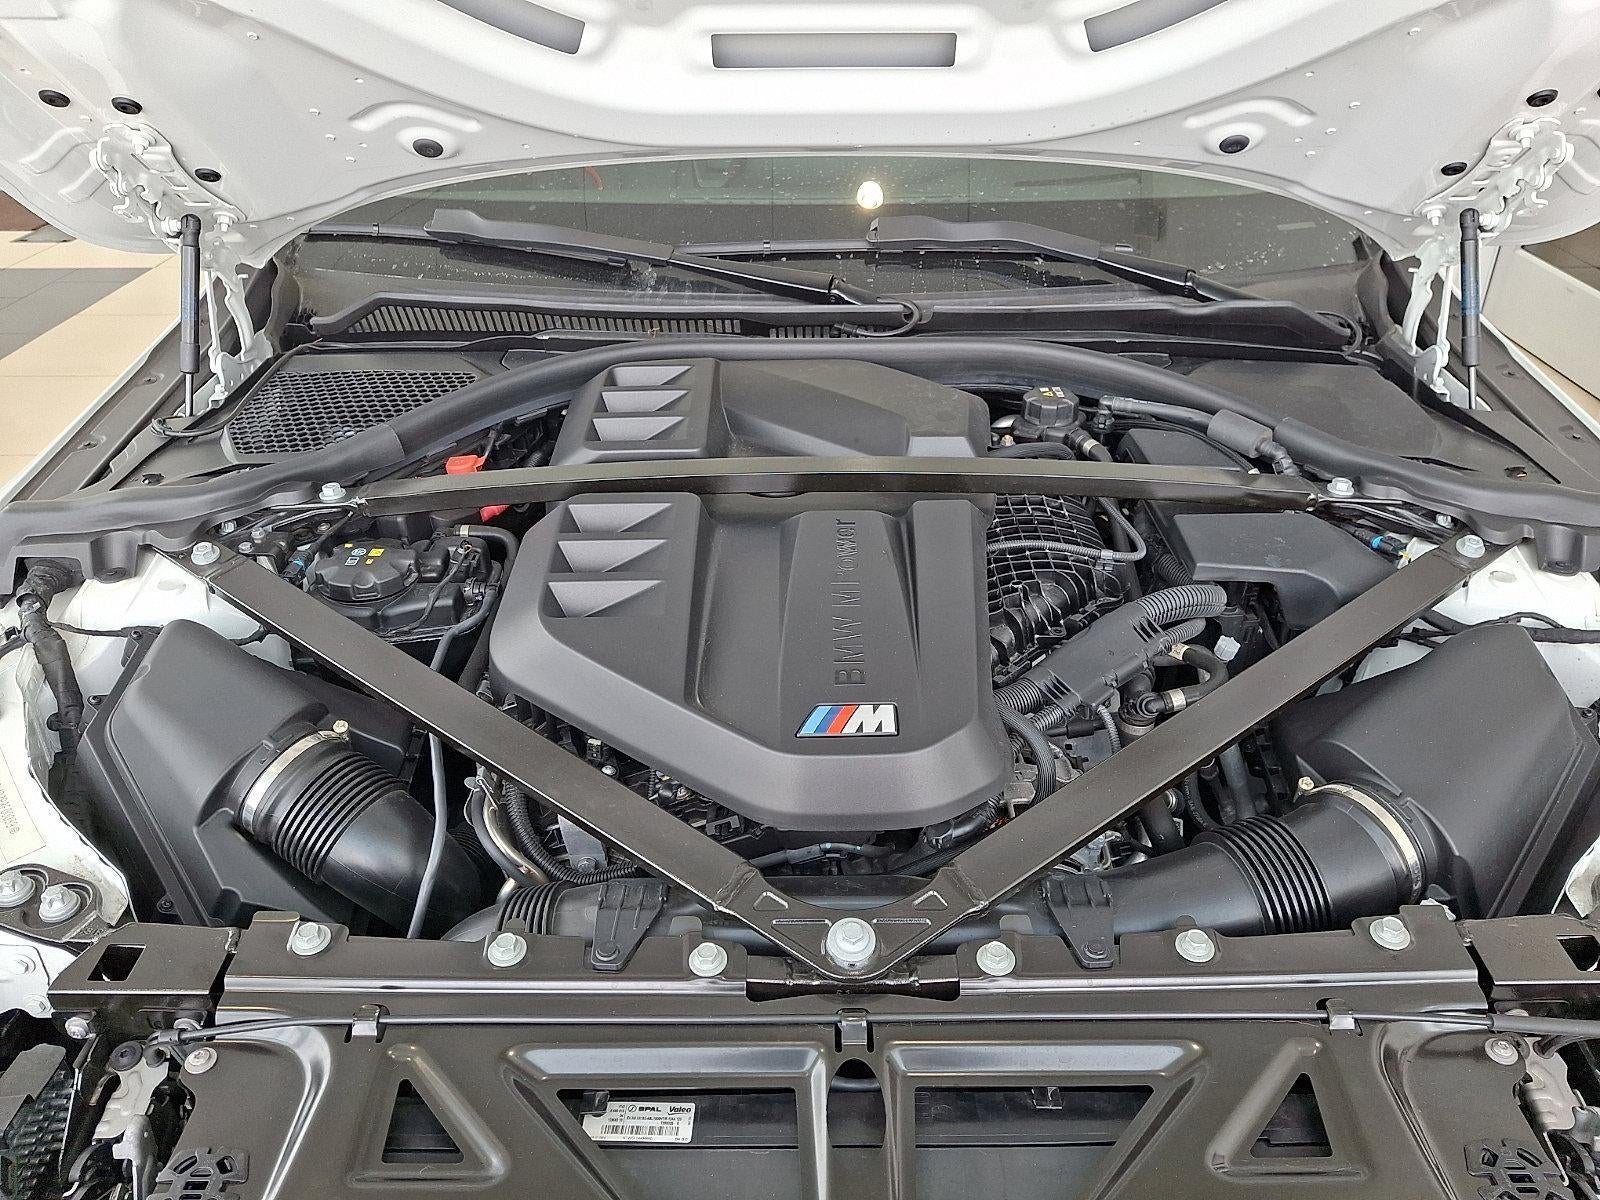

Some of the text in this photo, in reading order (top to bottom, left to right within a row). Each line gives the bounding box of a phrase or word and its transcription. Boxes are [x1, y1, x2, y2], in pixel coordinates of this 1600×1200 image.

[831, 590, 861, 606] M
[832, 616, 866, 687] BMW
[669, 1105, 692, 1113] Valeo
